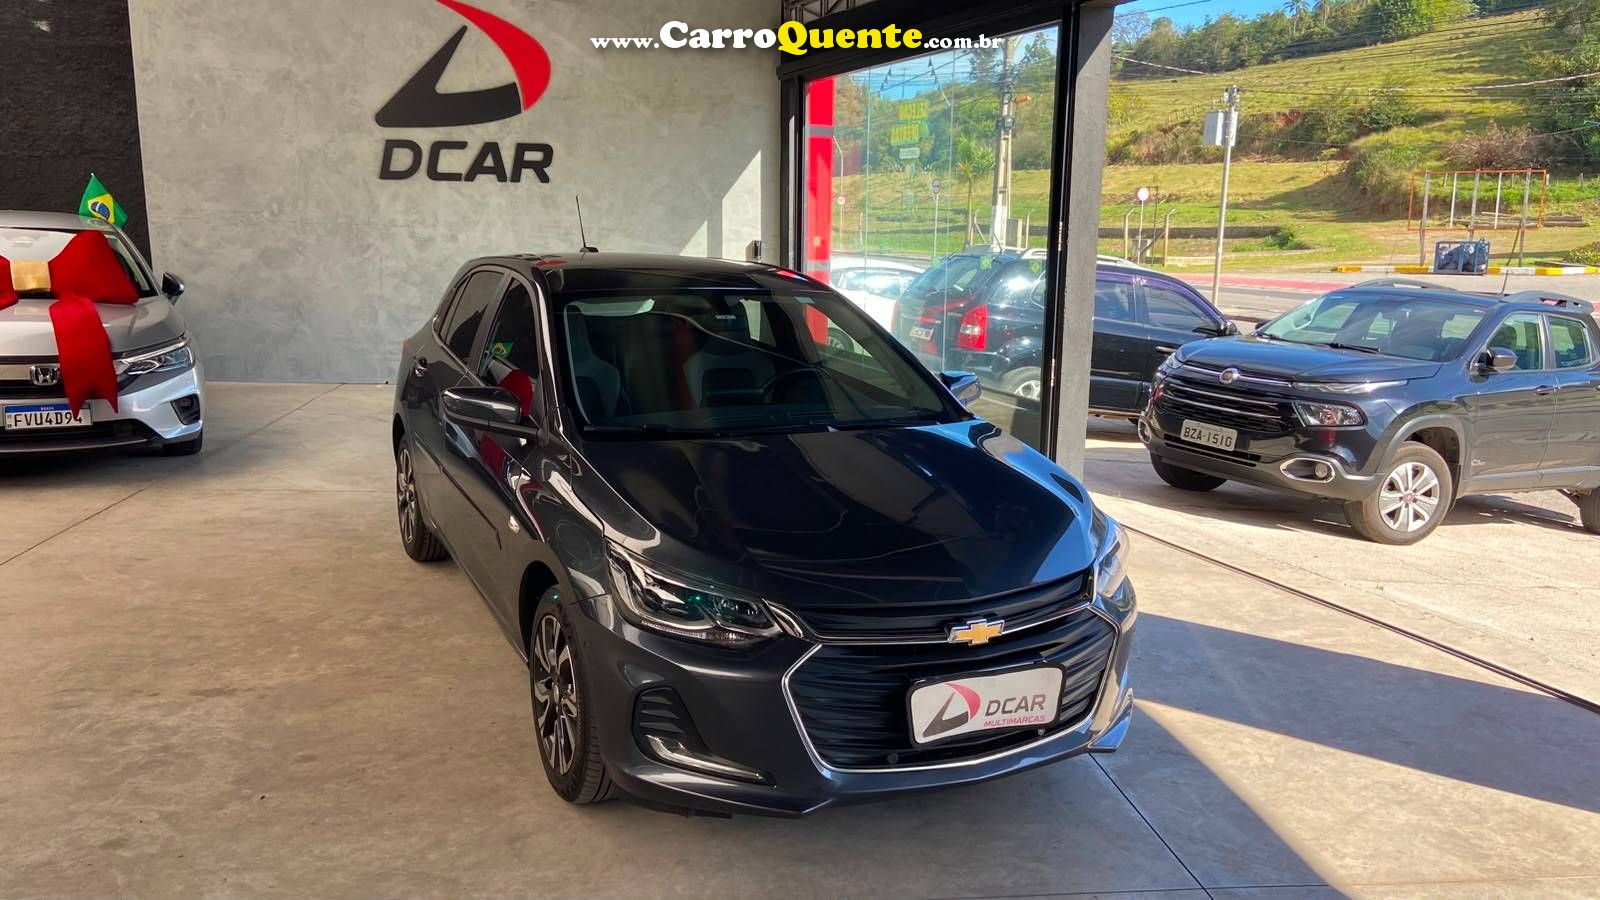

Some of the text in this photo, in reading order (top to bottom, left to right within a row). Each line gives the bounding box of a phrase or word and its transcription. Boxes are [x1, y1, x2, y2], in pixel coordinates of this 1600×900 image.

[379, 139, 554, 183] DCAR
[1183, 426, 1233, 448] BZA-1510
[984, 693, 1046, 717] DCAR
[983, 714, 1047, 728] MULTIMARCAS
